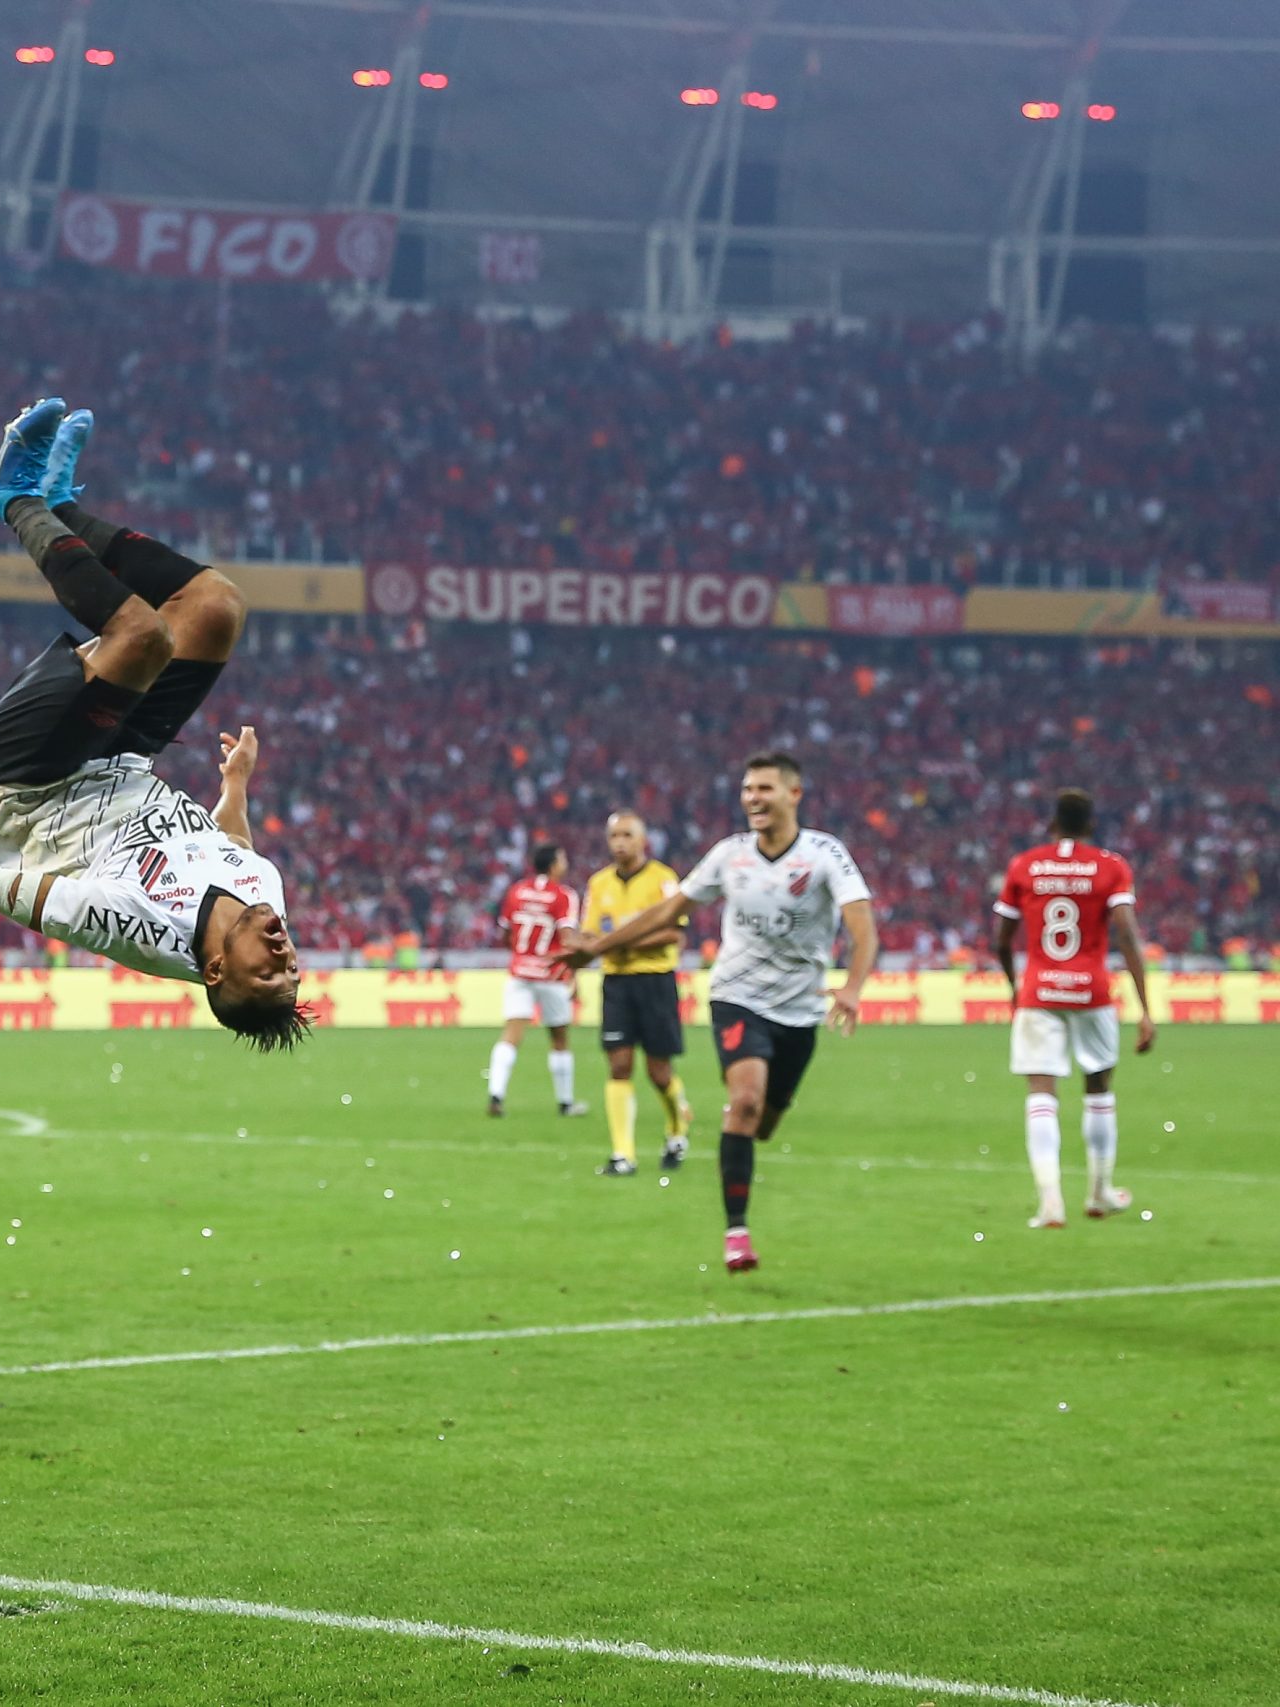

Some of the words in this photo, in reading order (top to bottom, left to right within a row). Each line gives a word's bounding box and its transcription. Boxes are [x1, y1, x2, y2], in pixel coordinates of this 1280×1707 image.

[137, 210, 317, 277] FICO
[425, 566, 773, 628] SUPERFICO
[512, 910, 557, 956] 77
[1041, 896, 1082, 962] 8
